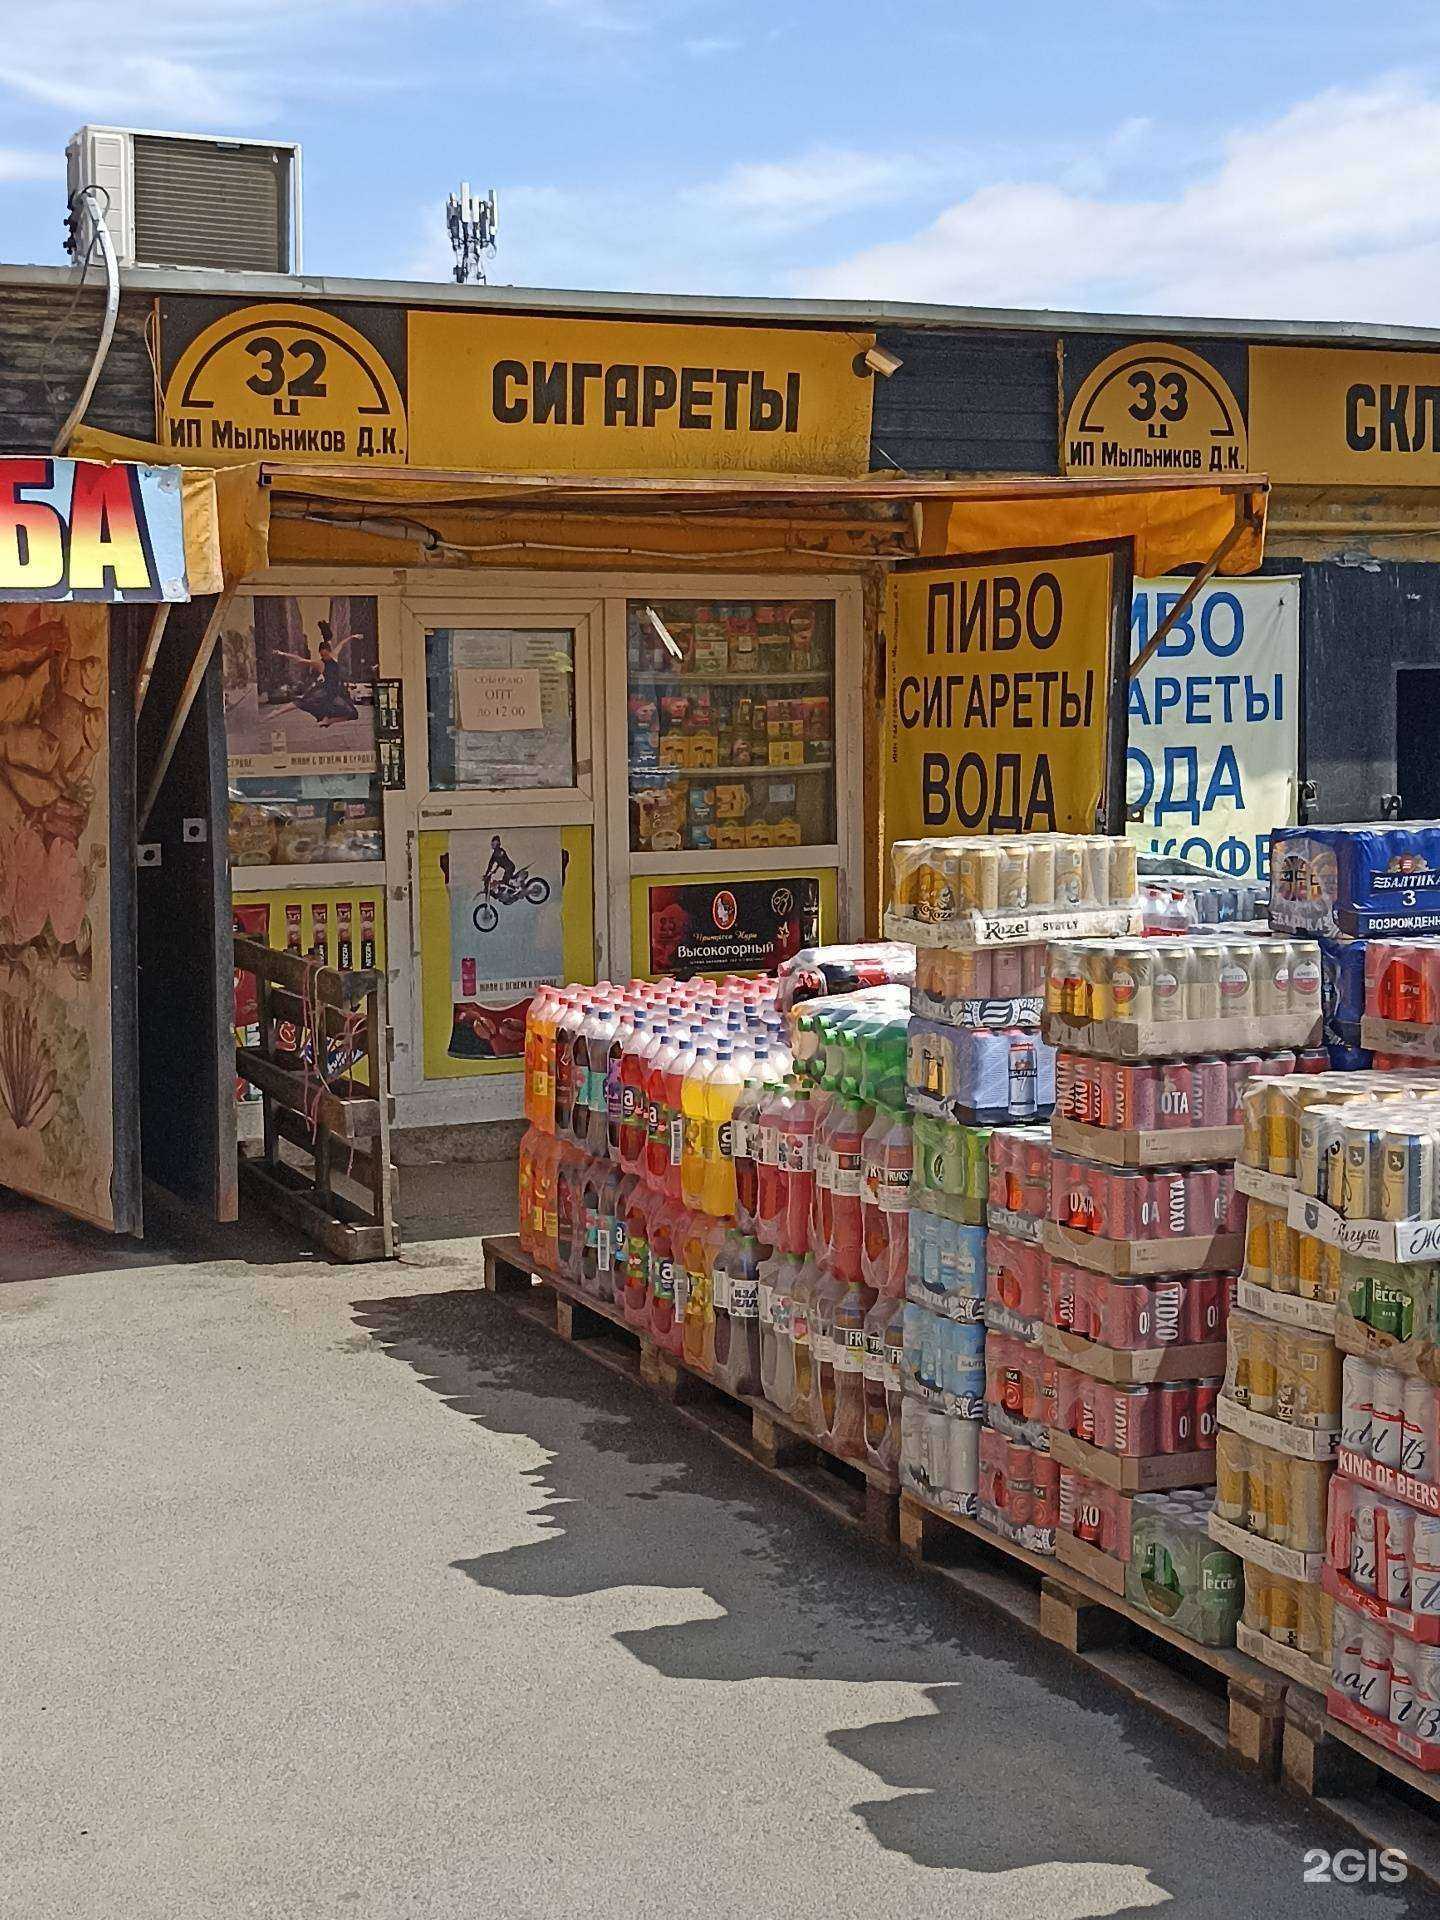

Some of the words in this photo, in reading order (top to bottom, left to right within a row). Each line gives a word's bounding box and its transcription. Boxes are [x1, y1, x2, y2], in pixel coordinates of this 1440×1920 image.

[245, 337, 327, 398] 32
[492, 360, 801, 432] СИГАРЕТЫ
[1127, 371, 1189, 421] 33
[169, 418, 201, 448] ИП
[211, 419, 345, 453] Мыльников
[356, 426, 404, 457] Д.К.
[1070, 441, 1095, 467] ИП
[1101, 442, 1201, 468] Мыльников
[1209, 446, 1245, 472] Д.К.
[926, 572, 1063, 655] ПИВО
[484, 689, 512, 700] ОПТ
[899, 669, 1094, 730] СИГАРЕТЫ
[922, 751, 1057, 834] ВОДА
[1402, 889, 1417, 906] 3
[677, 941, 775, 959] Высокогорный
[1017, 1077, 1027, 1091] 7
[1170, 1179, 1185, 1232] ОХОТА
[1155, 1286, 1179, 1341] ОХОТА
[1338, 1450, 1371, 1480] KING
[1375, 1463, 1394, 1486] OF
[1396, 1473, 1439, 1509] BEERS
